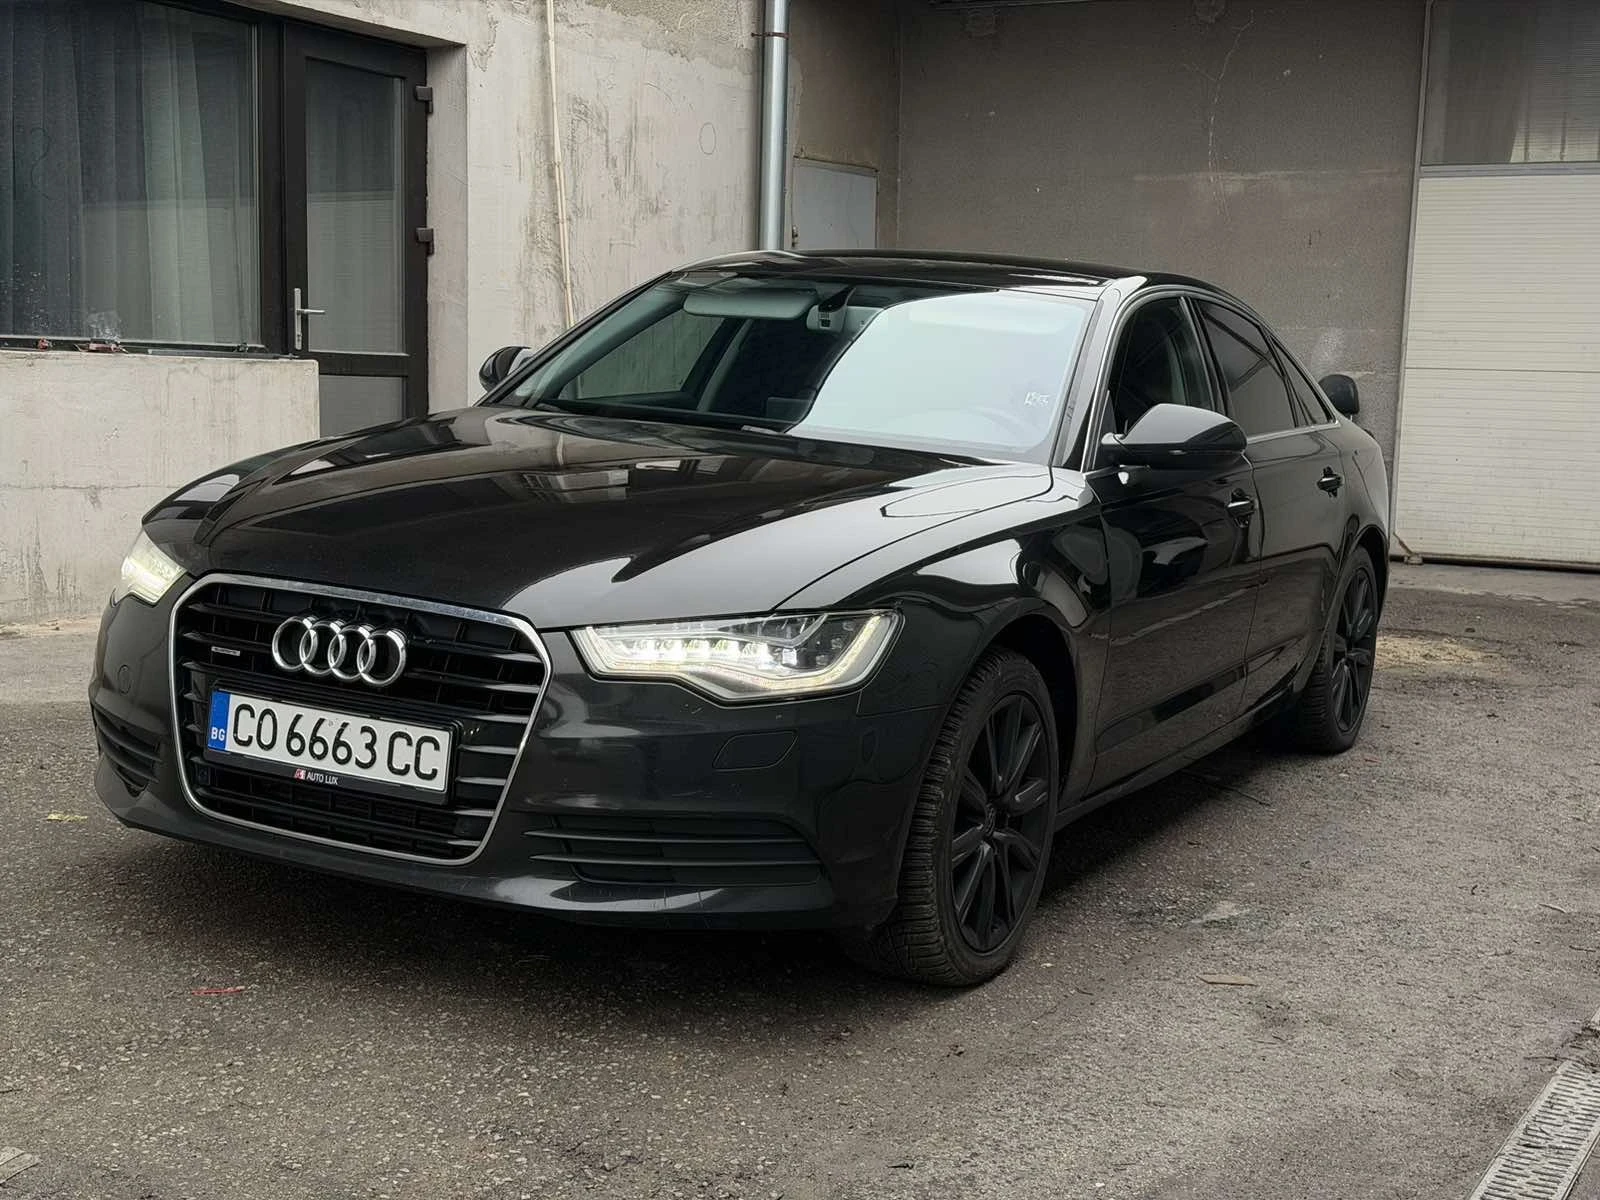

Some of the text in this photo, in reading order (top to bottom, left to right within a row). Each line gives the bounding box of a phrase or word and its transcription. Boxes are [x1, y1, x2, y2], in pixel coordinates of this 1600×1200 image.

[211, 727, 225, 742] BG
[286, 713, 377, 769] 6663
[387, 731, 440, 781] CC
[306, 772, 324, 783] AUTO
[325, 775, 338, 785] LUX
